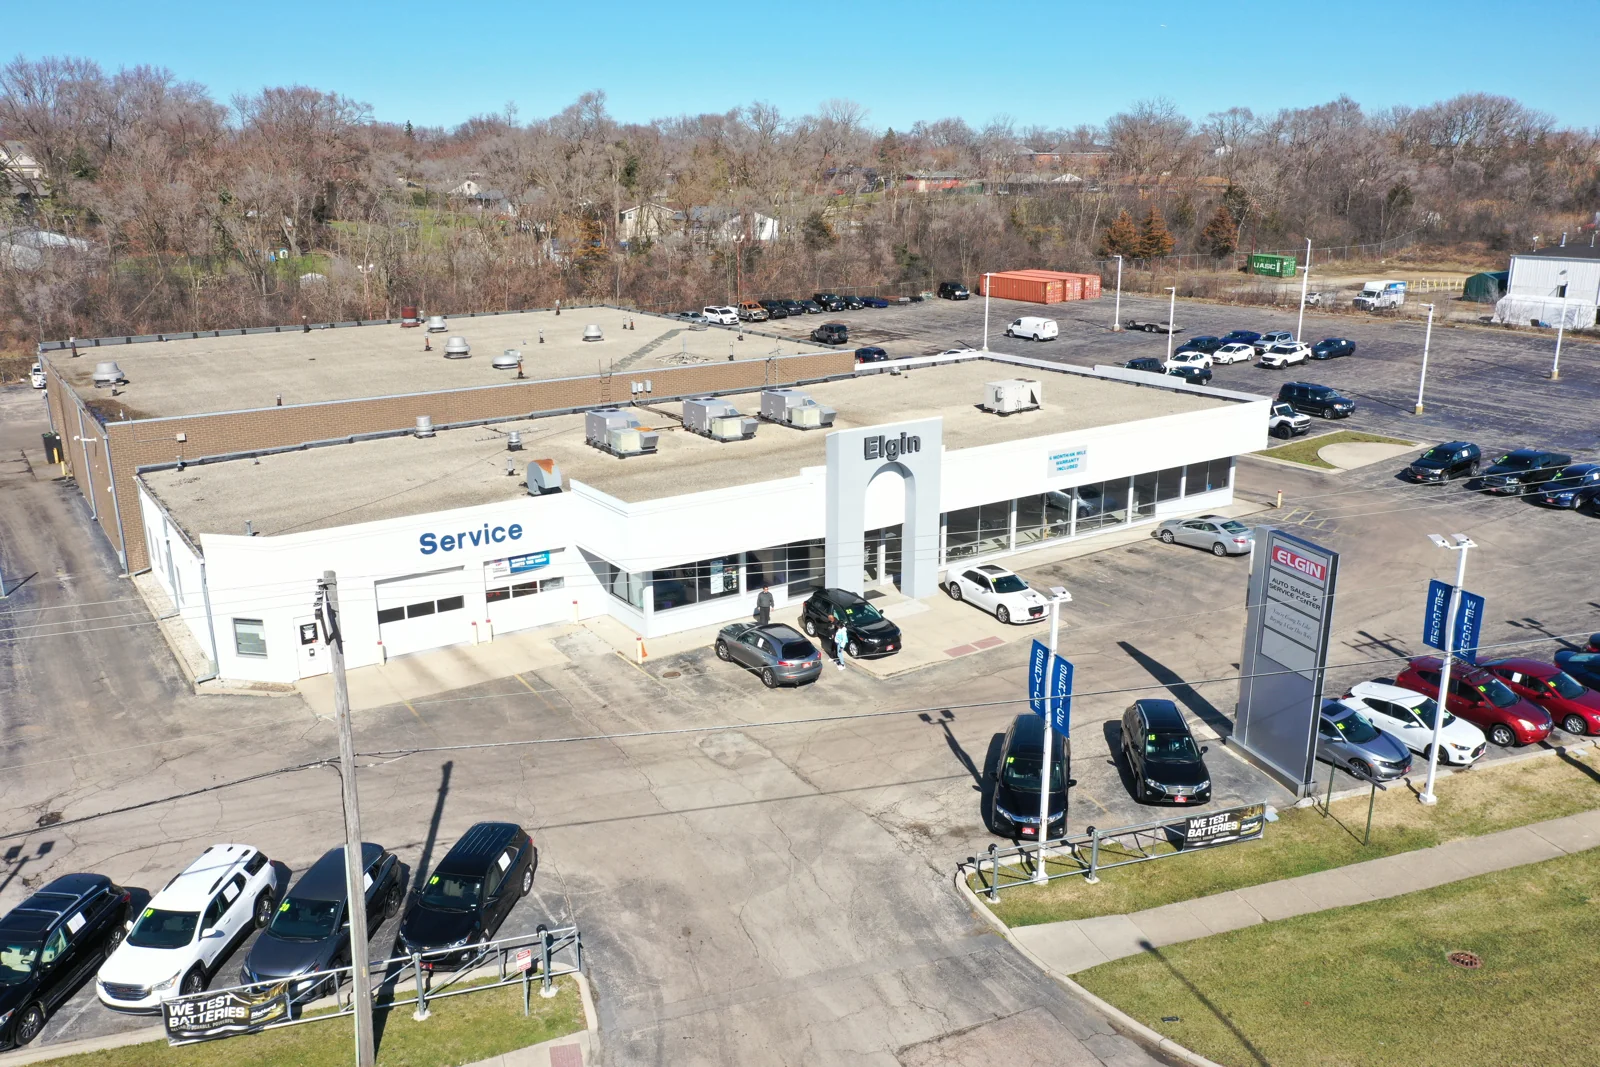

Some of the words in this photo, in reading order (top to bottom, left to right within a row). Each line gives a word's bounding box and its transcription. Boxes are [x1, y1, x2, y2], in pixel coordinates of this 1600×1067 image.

[864, 432, 921, 461] Elgin
[419, 523, 523, 555] Service
[1277, 550, 1322, 578] ELGIN
[1269, 583, 1294, 599] SERVICE
[1296, 596, 1321, 611] CENTER
[1272, 578, 1289, 589] AUTO
[1290, 586, 1311, 599] SALES
[1430, 588, 1445, 645] WELCOME
[1460, 600, 1476, 657] WELCOME
[1034, 649, 1044, 710] SERVICE
[1057, 664, 1068, 727] SERVICE
[1187, 821, 1238, 837] BATTERIES
[1190, 818, 1208, 828] WE
[1209, 813, 1230, 825] TEST
[169, 1003, 194, 1016] WE
[197, 995, 232, 1012] TEST
[169, 1006, 246, 1027] BATTERIES
